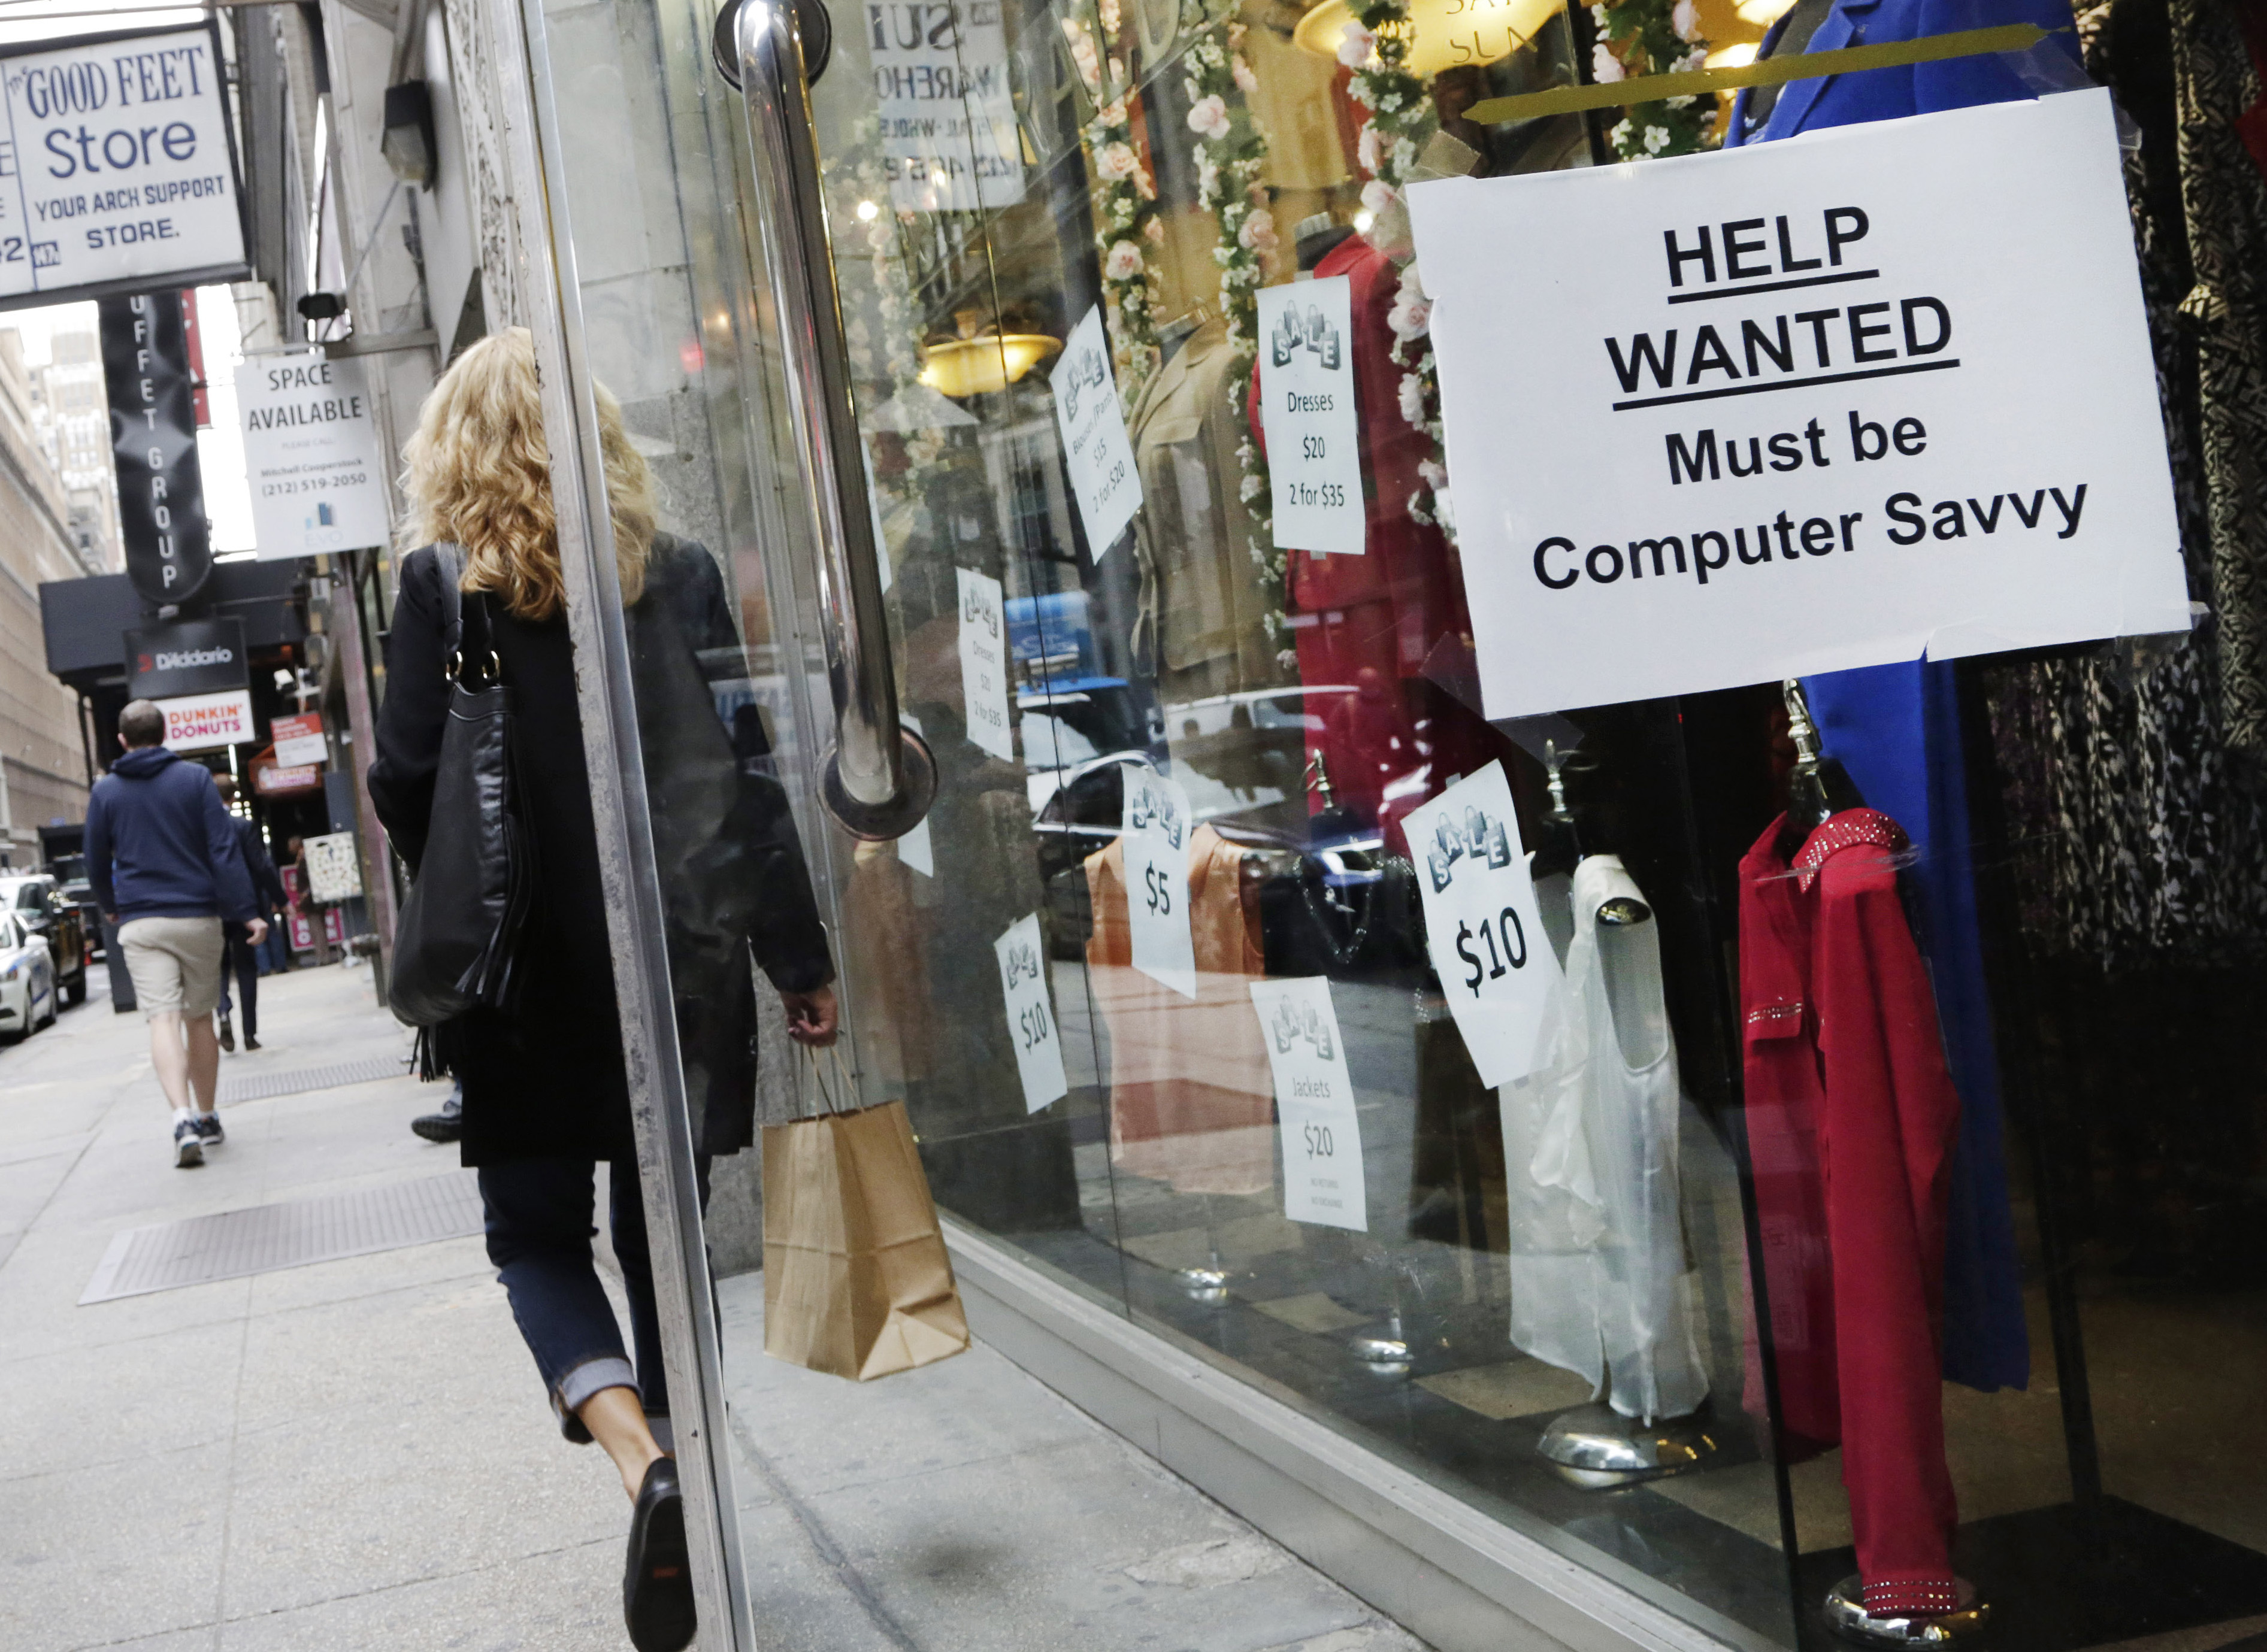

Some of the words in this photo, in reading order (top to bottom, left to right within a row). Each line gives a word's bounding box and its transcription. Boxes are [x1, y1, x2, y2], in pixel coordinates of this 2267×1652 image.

[26, 62, 108, 119] GOOD
[113, 45, 204, 106] FEET
[45, 122, 196, 178] Store
[35, 195, 87, 222] YOUR
[93, 187, 140, 213] ARCH
[144, 175, 225, 205] SUPPORT
[87, 218, 181, 249] STORE.
[1663, 206, 1869, 287] HELP
[1275, 311, 1339, 368] SALE
[1605, 295, 1953, 393] WANTED
[269, 362, 333, 392] SPACE
[1288, 392, 1334, 413] Dresses
[249, 396, 363, 431] AVAILABLE
[130, 295, 158, 432] UFFET
[148, 447, 177, 589] GROUP
[1303, 434, 1325, 462] $20
[1665, 417, 1830, 485] Must
[1848, 410, 1927, 462] be
[262, 481, 298, 498] (212)
[301, 472, 367, 492] 519-2050
[1110, 460, 1125, 491] $20
[1290, 483, 1297, 505] 2
[1300, 483, 1318, 506] for
[1322, 481, 1345, 509] $35
[1533, 510, 1862, 590] Computer
[1885, 483, 2088, 546] Savvy
[170, 704, 243, 725] DUNKIN'
[171, 719, 241, 740] DONUTS
[1133, 793, 1182, 849] SALE
[1430, 819, 1509, 890] SALE
[1145, 859, 1170, 917] $5
[1455, 906, 1529, 999] $10
[1021, 1001, 1048, 1056] $10
[1275, 1006, 1333, 1059] SALE
[1293, 1076, 1331, 1098] Jackets
[1304, 1119, 1334, 1160] $20
